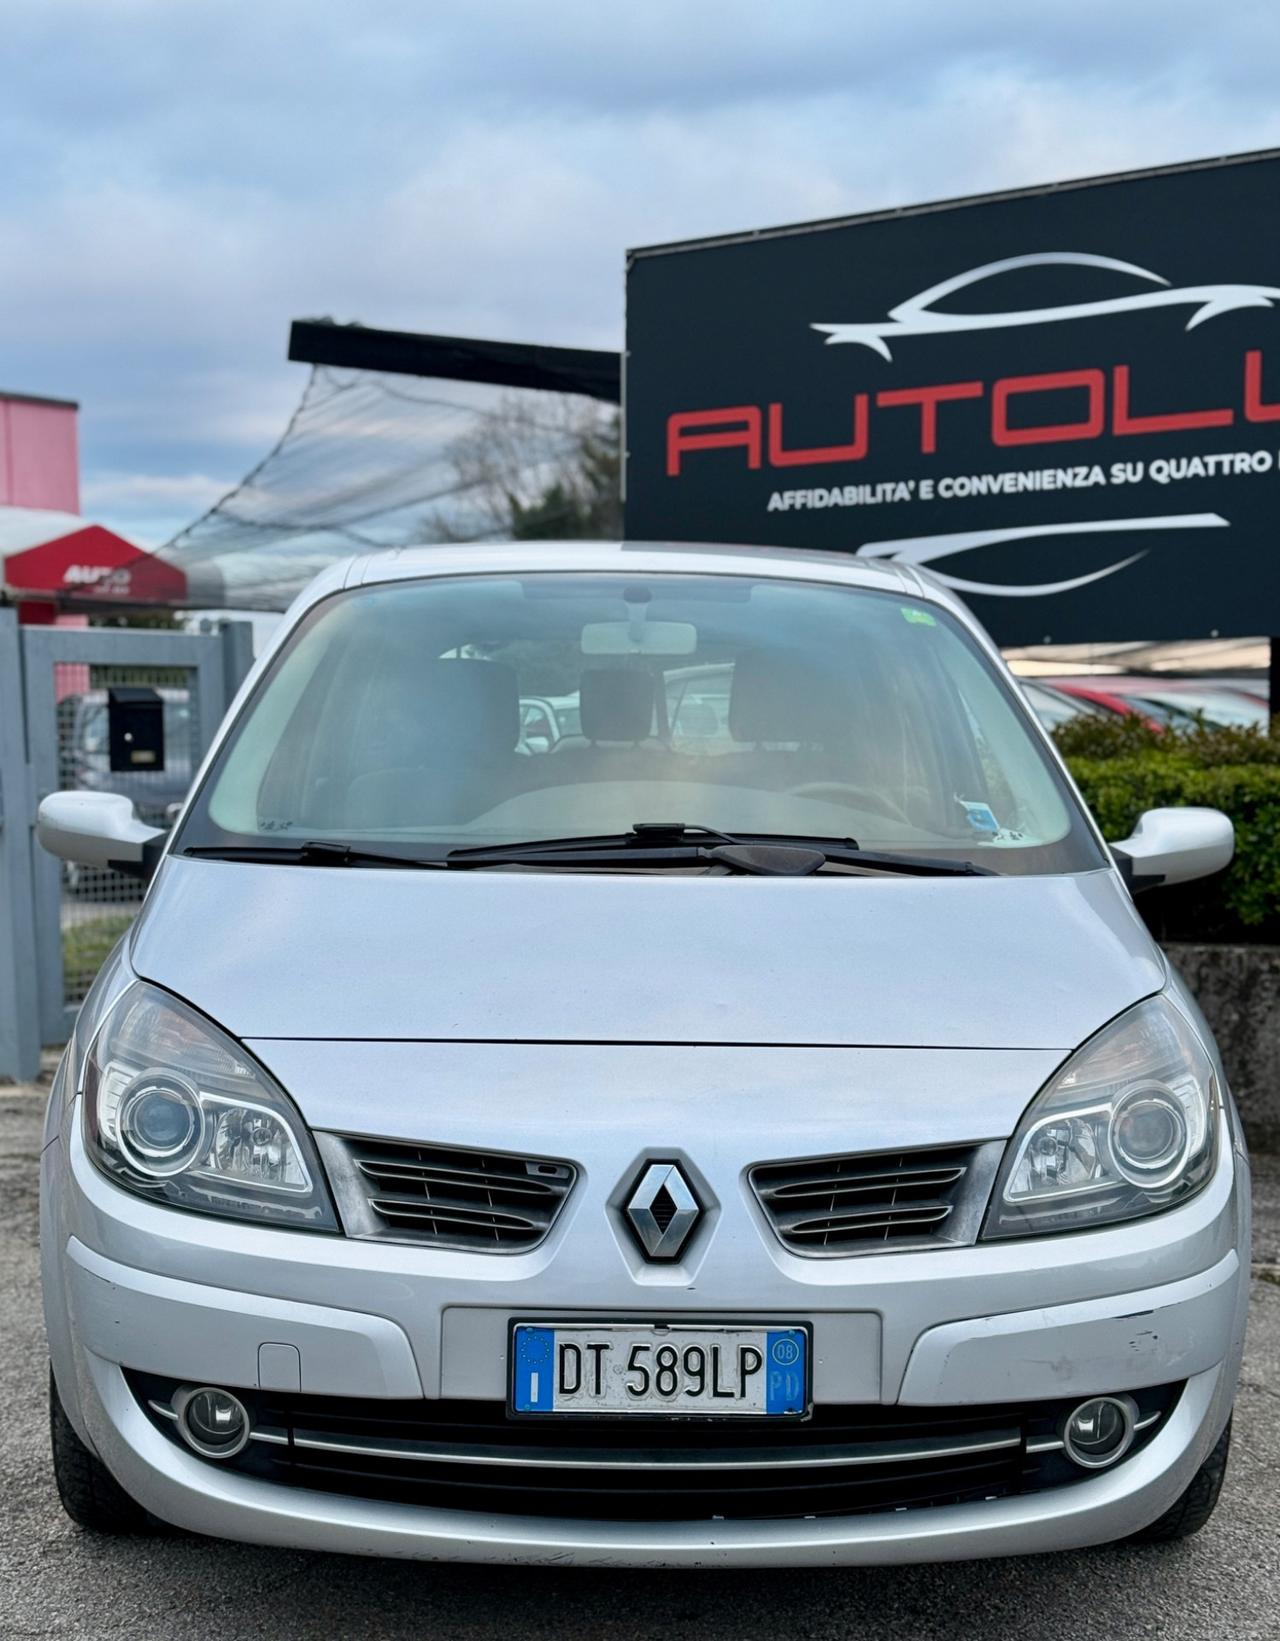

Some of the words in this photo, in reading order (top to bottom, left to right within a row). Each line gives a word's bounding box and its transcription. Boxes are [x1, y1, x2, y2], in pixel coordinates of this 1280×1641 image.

[767, 480, 916, 512] AFFIDABILITA'
[918, 479, 935, 500] E
[937, 464, 1106, 498] CONVENIENZA
[1110, 461, 1144, 485] SU
[1149, 450, 1273, 485] QUATTRO
[558, 1342, 611, 1396] DT
[626, 1344, 764, 1398] 589LP
[777, 1343, 794, 1360] 08
[770, 1370, 800, 1401] PD
